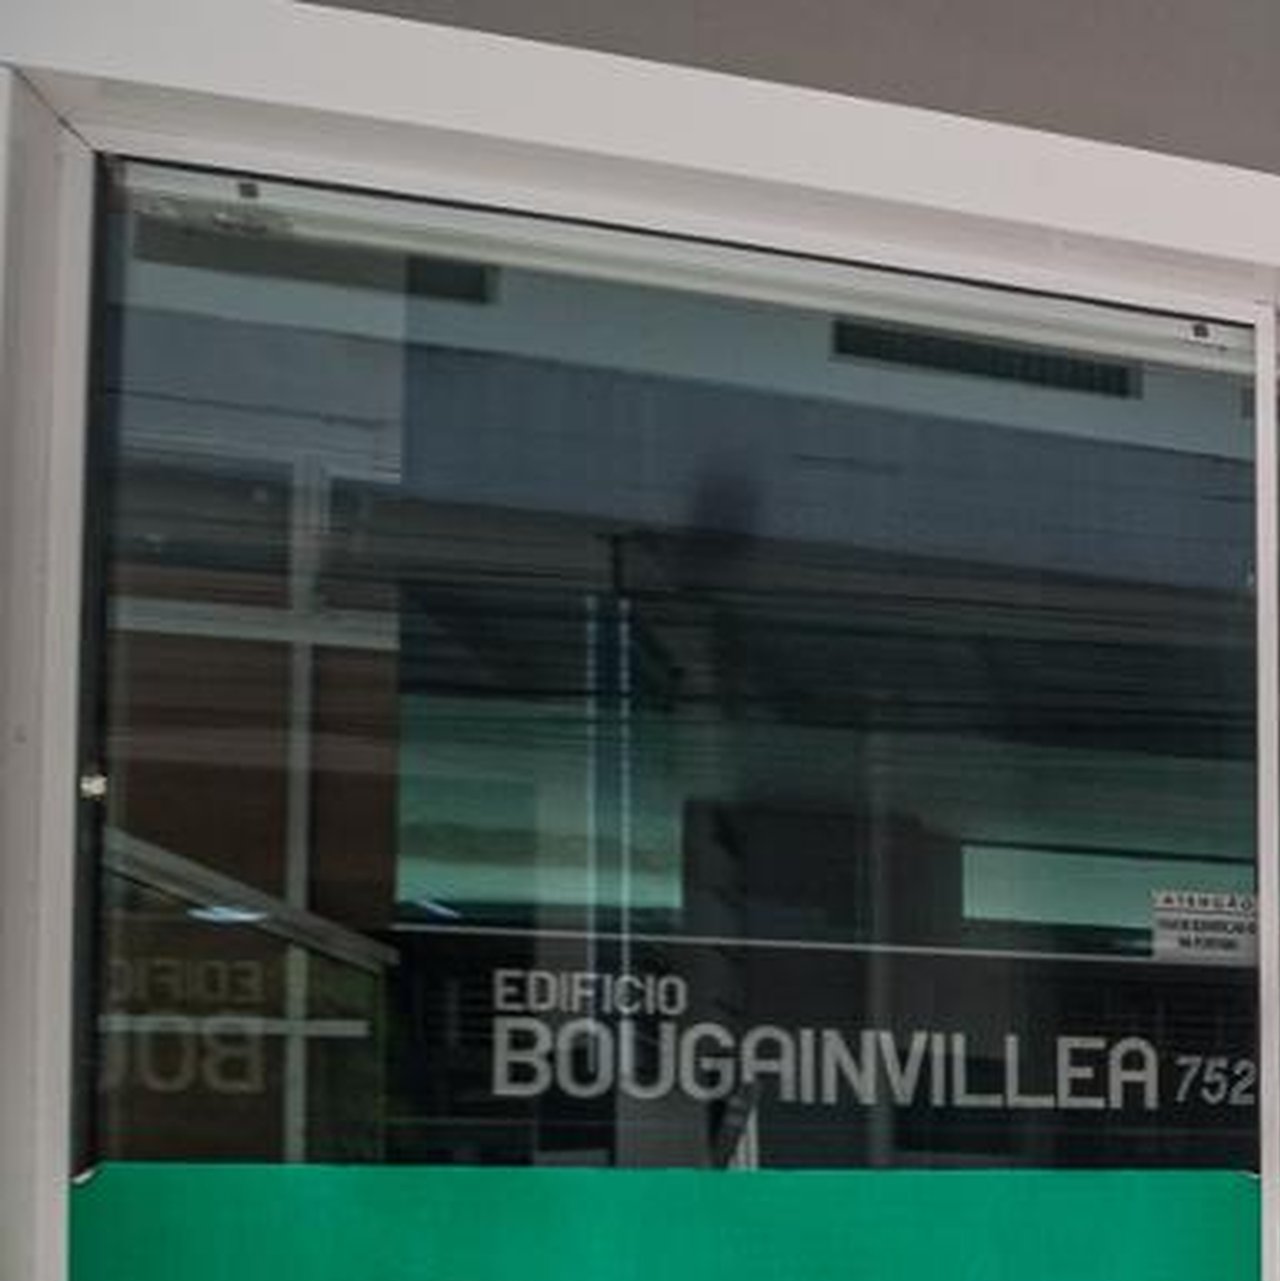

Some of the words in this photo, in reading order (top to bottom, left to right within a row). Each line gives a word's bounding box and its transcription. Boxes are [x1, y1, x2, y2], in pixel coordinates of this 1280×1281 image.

[492, 968, 690, 1017] EDIFICIO
[491, 1015, 1160, 1111] BOUGAINVILLEA
[1173, 1055, 1257, 1107] 752
